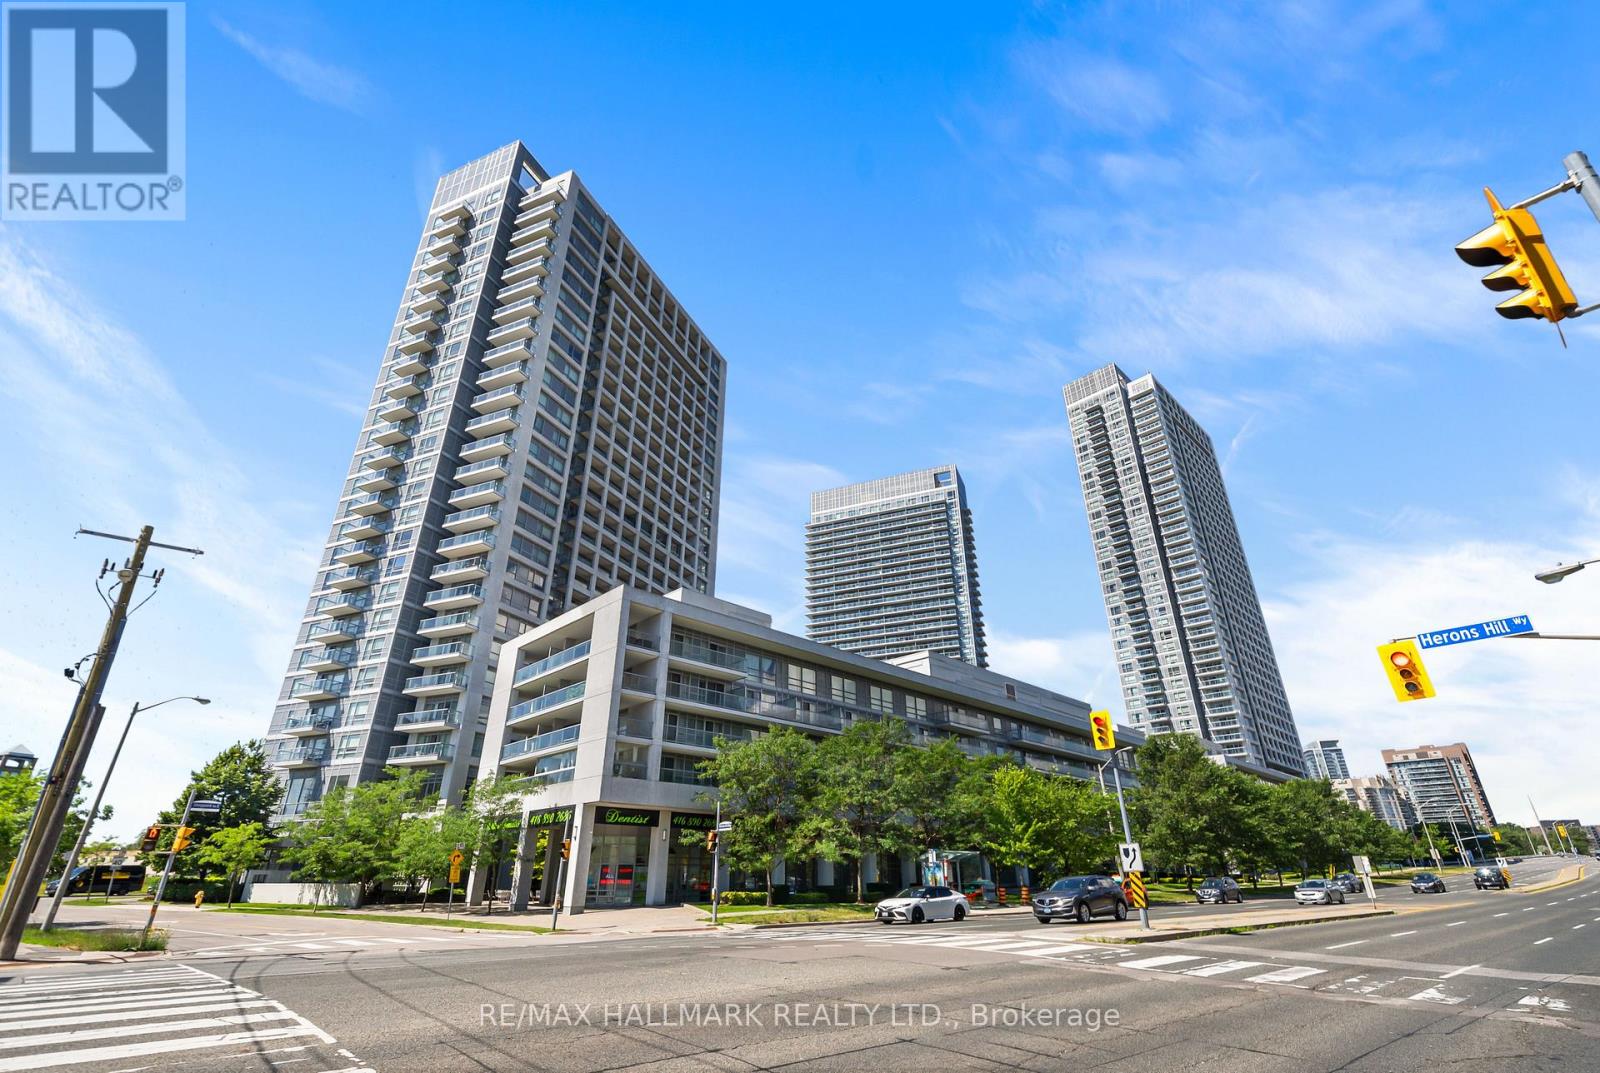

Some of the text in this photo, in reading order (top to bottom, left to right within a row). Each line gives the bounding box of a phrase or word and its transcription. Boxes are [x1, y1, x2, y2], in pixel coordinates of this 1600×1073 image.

[1420, 616, 1527, 647] Herons Hill Wy
[606, 809, 650, 825] Dentist
[673, 815, 686, 827] 416
